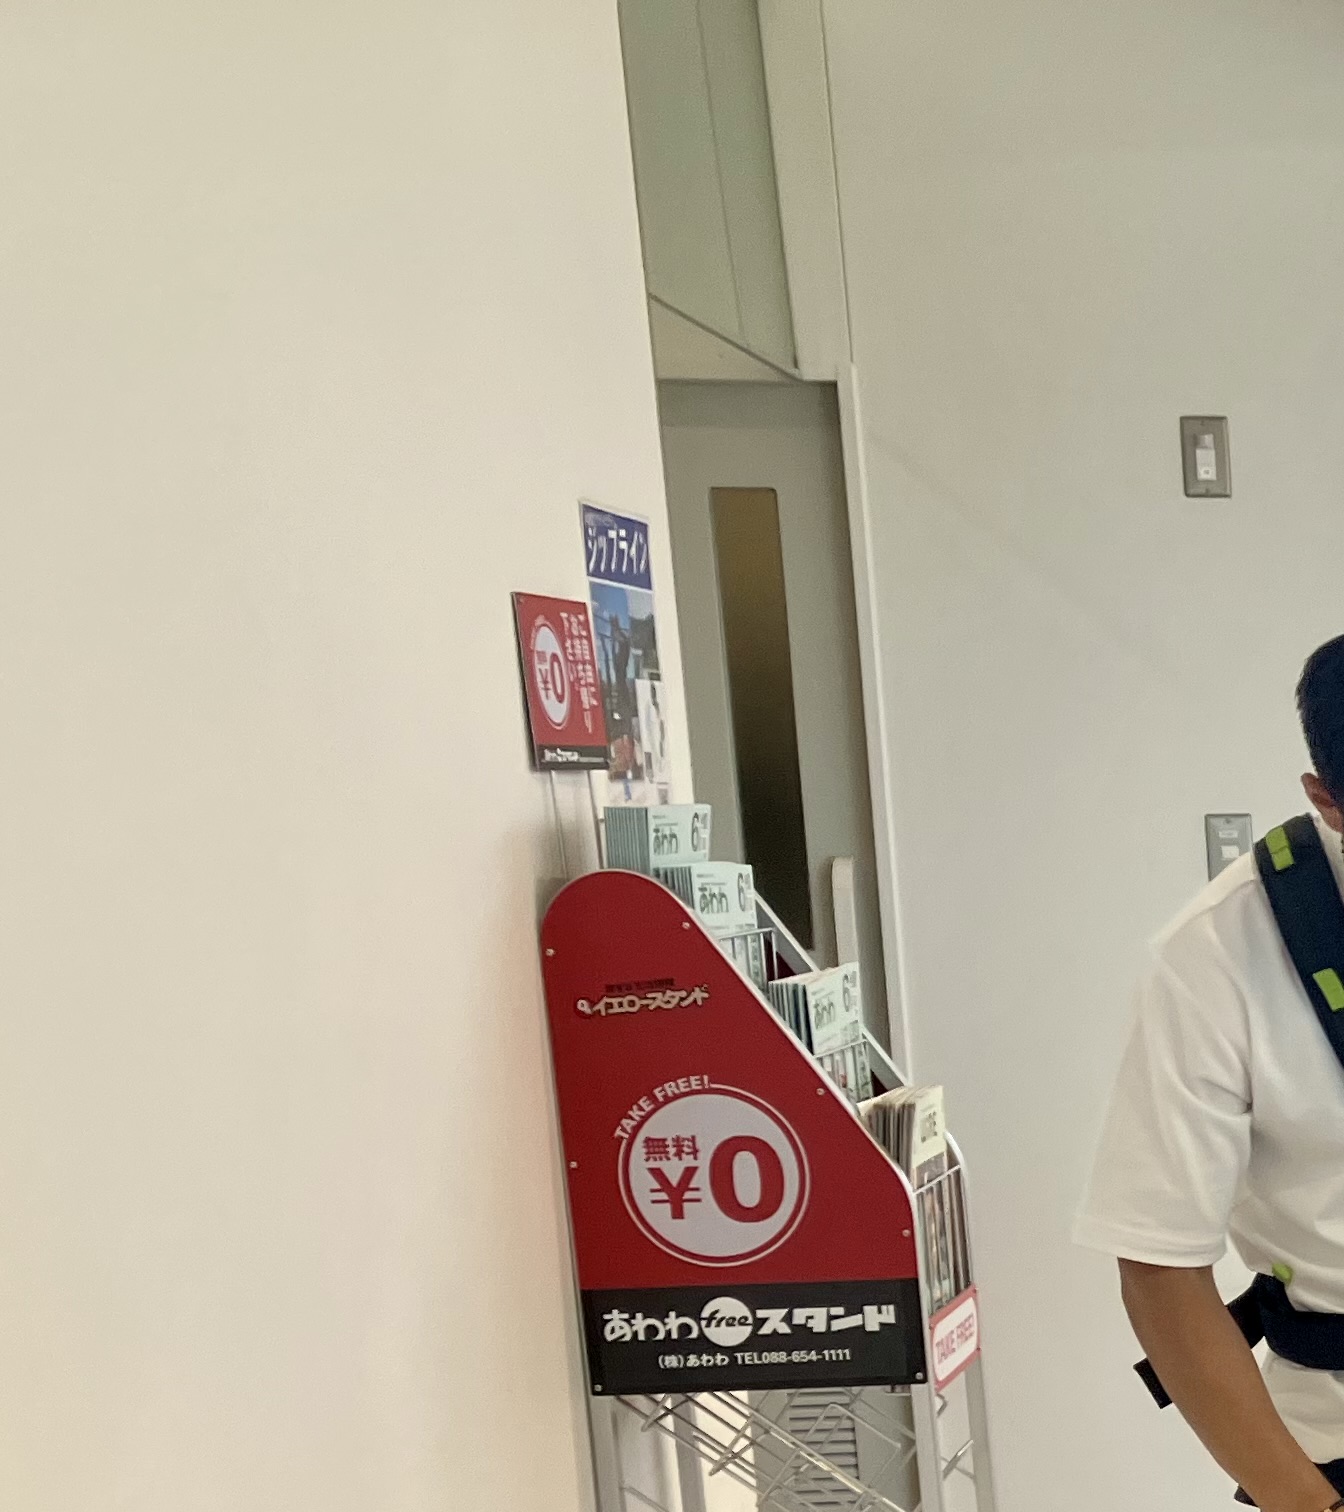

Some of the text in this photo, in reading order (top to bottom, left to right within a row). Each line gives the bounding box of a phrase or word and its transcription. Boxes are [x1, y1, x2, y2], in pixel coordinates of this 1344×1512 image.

[586, 526, 648, 575] ジップライン
[614, 1074, 710, 1140] TAKE FREE!
[643, 1134, 699, 1162] 無料
[603, 1308, 699, 1342] あわわ
[755, 1304, 897, 1336] スタンド
[735, 1348, 851, 1365] TEL088-654-1111
